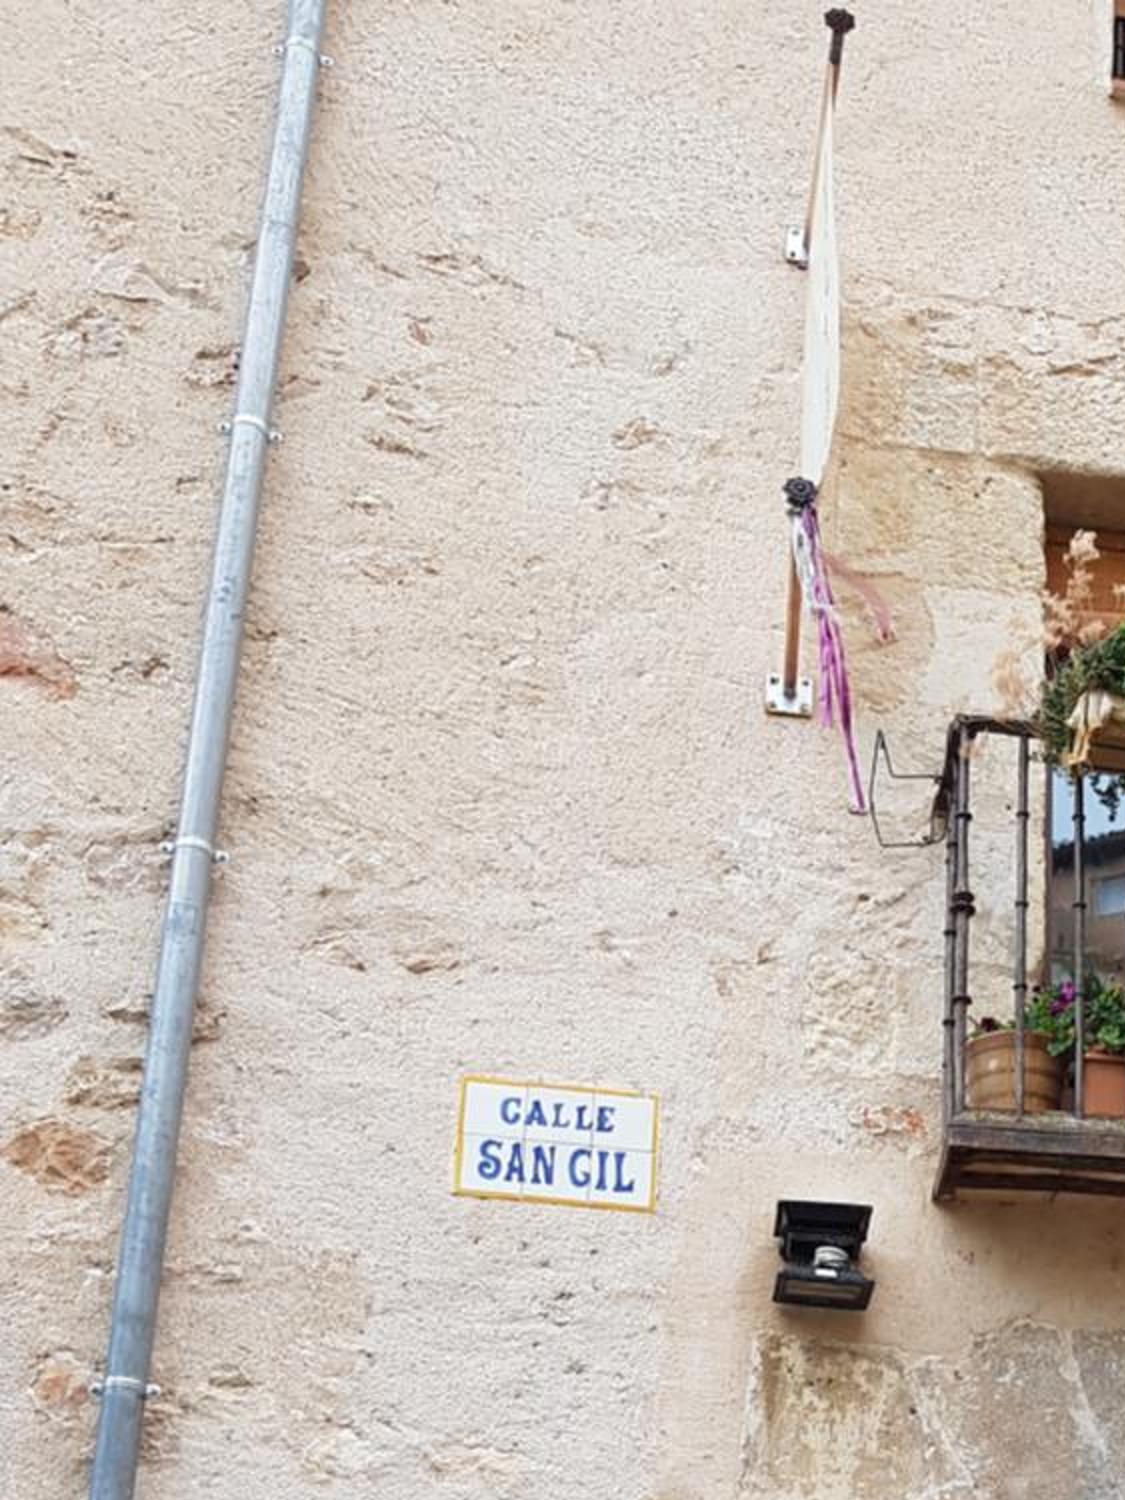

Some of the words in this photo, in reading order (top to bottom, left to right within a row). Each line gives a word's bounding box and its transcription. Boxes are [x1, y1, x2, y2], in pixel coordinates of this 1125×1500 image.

[500, 1097, 616, 1133] CALLE
[477, 1139, 556, 1185] SAN
[568, 1148, 636, 1193] GIL
